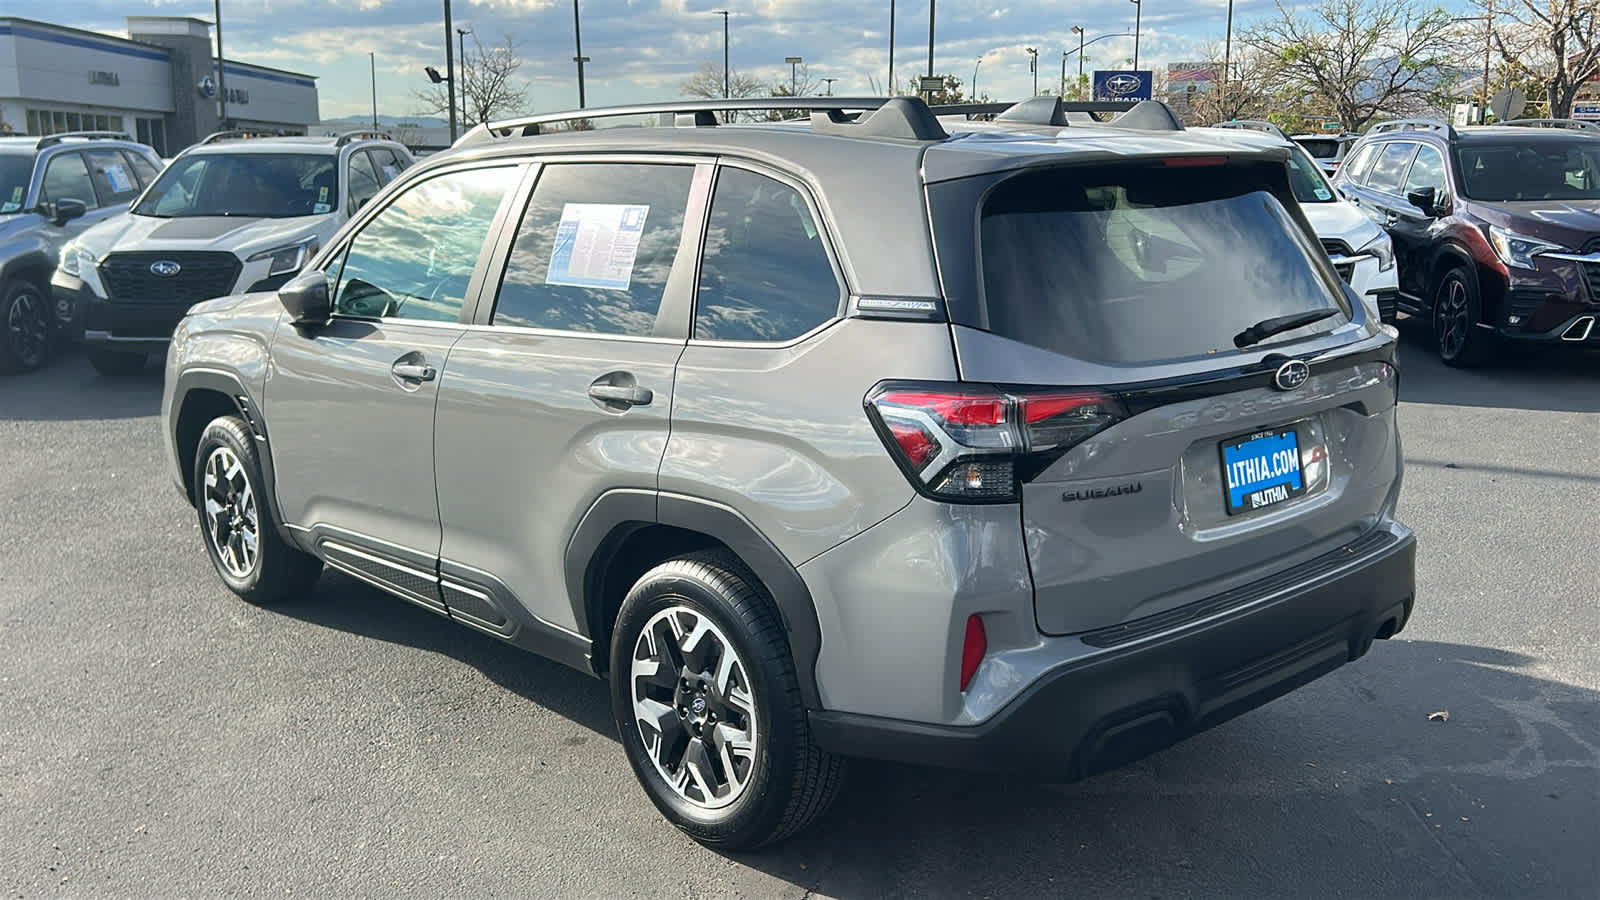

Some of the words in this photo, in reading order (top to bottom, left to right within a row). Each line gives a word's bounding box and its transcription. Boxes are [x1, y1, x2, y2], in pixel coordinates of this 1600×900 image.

[1226, 448, 1300, 488] LITHIA.COM
[1062, 482, 1143, 502] SUBARU
[1260, 485, 1289, 505] LITHIA
